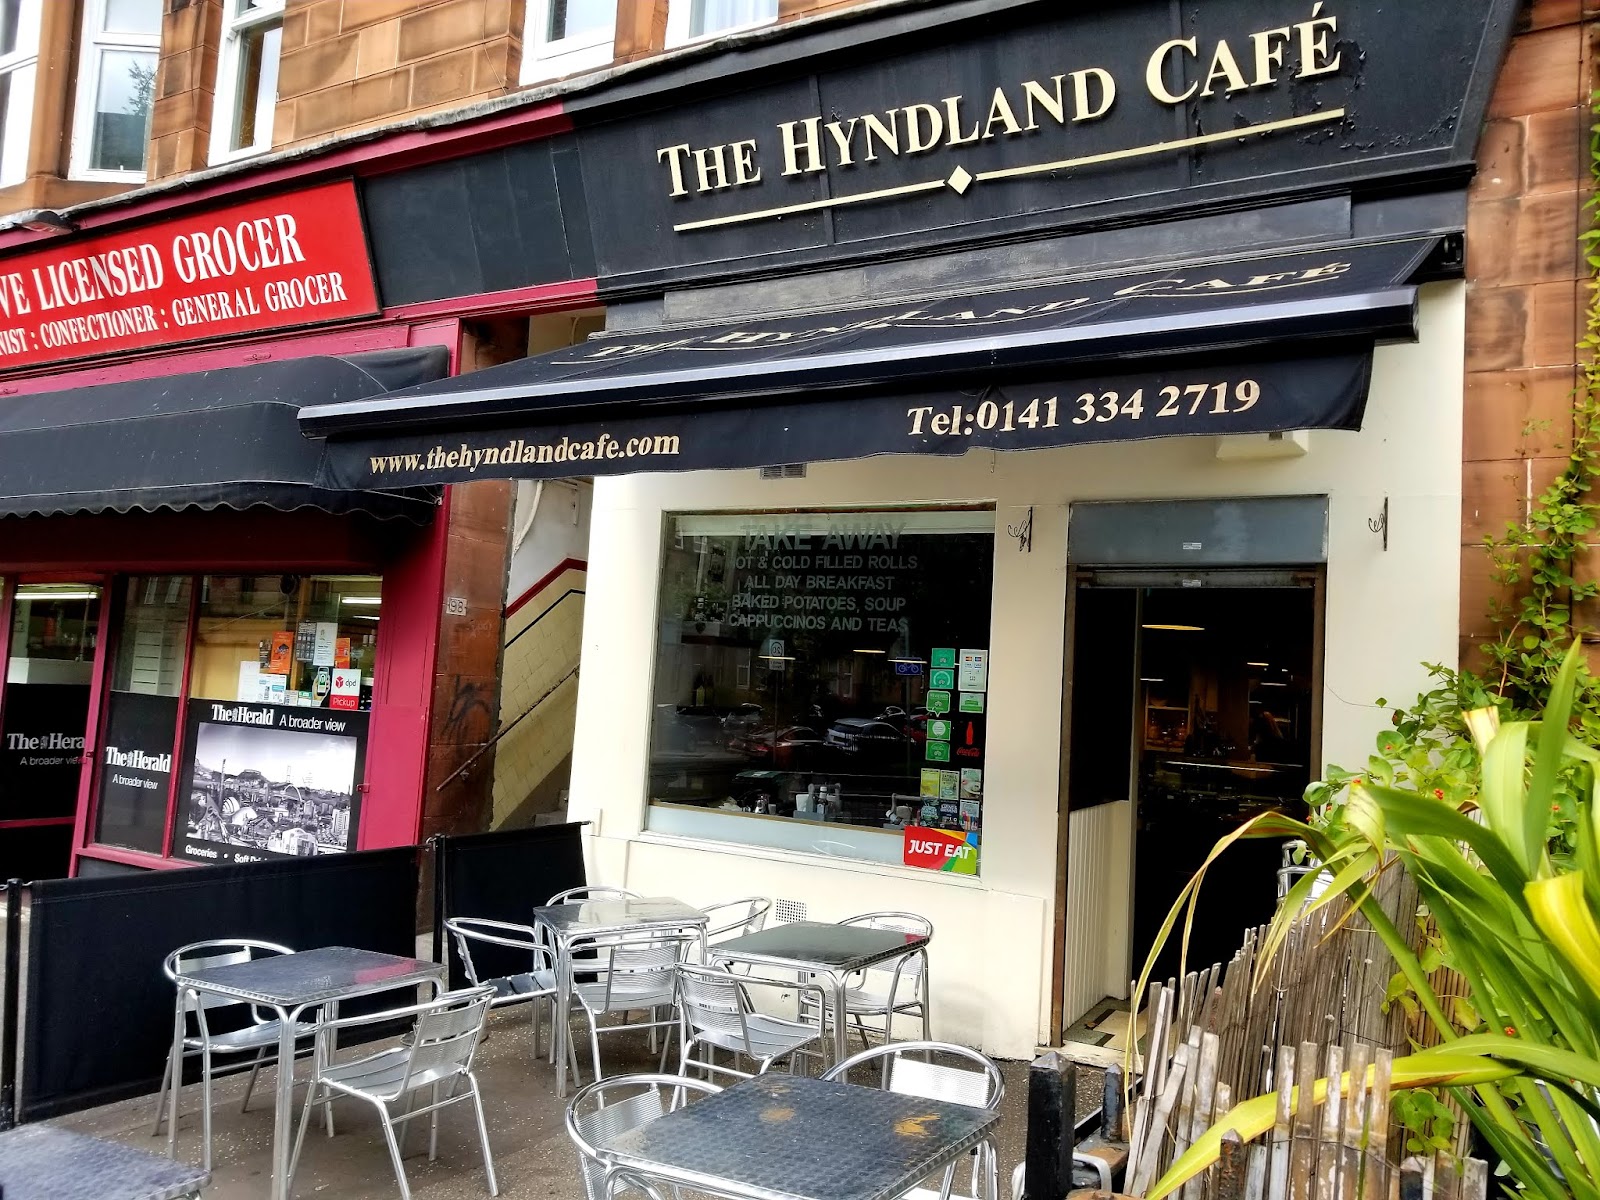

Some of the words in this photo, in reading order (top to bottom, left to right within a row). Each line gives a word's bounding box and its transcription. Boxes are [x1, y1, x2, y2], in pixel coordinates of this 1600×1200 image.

[656, 138, 761, 198] THE
[776, 67, 1117, 178] HYNDLAND
[1144, 2, 1346, 105] CAFÉ
[31, 243, 164, 310] LICENSED
[172, 213, 306, 284] GROCER
[40, 306, 158, 348] CONFECTIONER
[172, 287, 261, 328] GENERAL
[264, 271, 348, 317] GROCER
[1072, 388, 1144, 425] 334
[1155, 379, 1261, 418] 2719
[369, 433, 680, 474] www.thehyndlandcafe.com
[740, 524, 812, 550] TAKE
[821, 522, 907, 550] AWAY
[730, 556, 754, 569] OT
[757, 556, 768, 569] &
[772, 555, 811, 569] COLD
[815, 555, 863, 569] FILLED
[868, 555, 918, 569] ROLLS
[744, 575, 770, 589] ALL
[775, 575, 802, 588] DAY
[806, 576, 895, 590] BREAKFAST
[732, 594, 779, 609] BAKED
[783, 595, 860, 613] POTATOES,
[864, 597, 906, 611] SOUP
[728, 614, 826, 629] CAPPUCCINOS
[830, 617, 862, 631] AND
[867, 618, 909, 632] TEAS
[345, 677, 357, 688] dpd
[332, 697, 355, 708] Pickup
[211, 704, 232, 722] The
[238, 706, 275, 726] Herald
[279, 715, 287, 726] A
[288, 715, 323, 731] broader
[324, 718, 346, 732] view
[7, 733, 39, 750] The
[20, 756, 28, 765] A
[30, 756, 64, 765] broader
[106, 746, 128, 766] The
[133, 749, 172, 773] Herald
[112, 773, 119, 783] A
[119, 774, 143, 788] broader
[143, 778, 158, 790] view
[185, 844, 218, 859] Groceries
[234, 853, 250, 864] Soft
[908, 839, 942, 855] JUST
[944, 844, 972, 860] EAT
